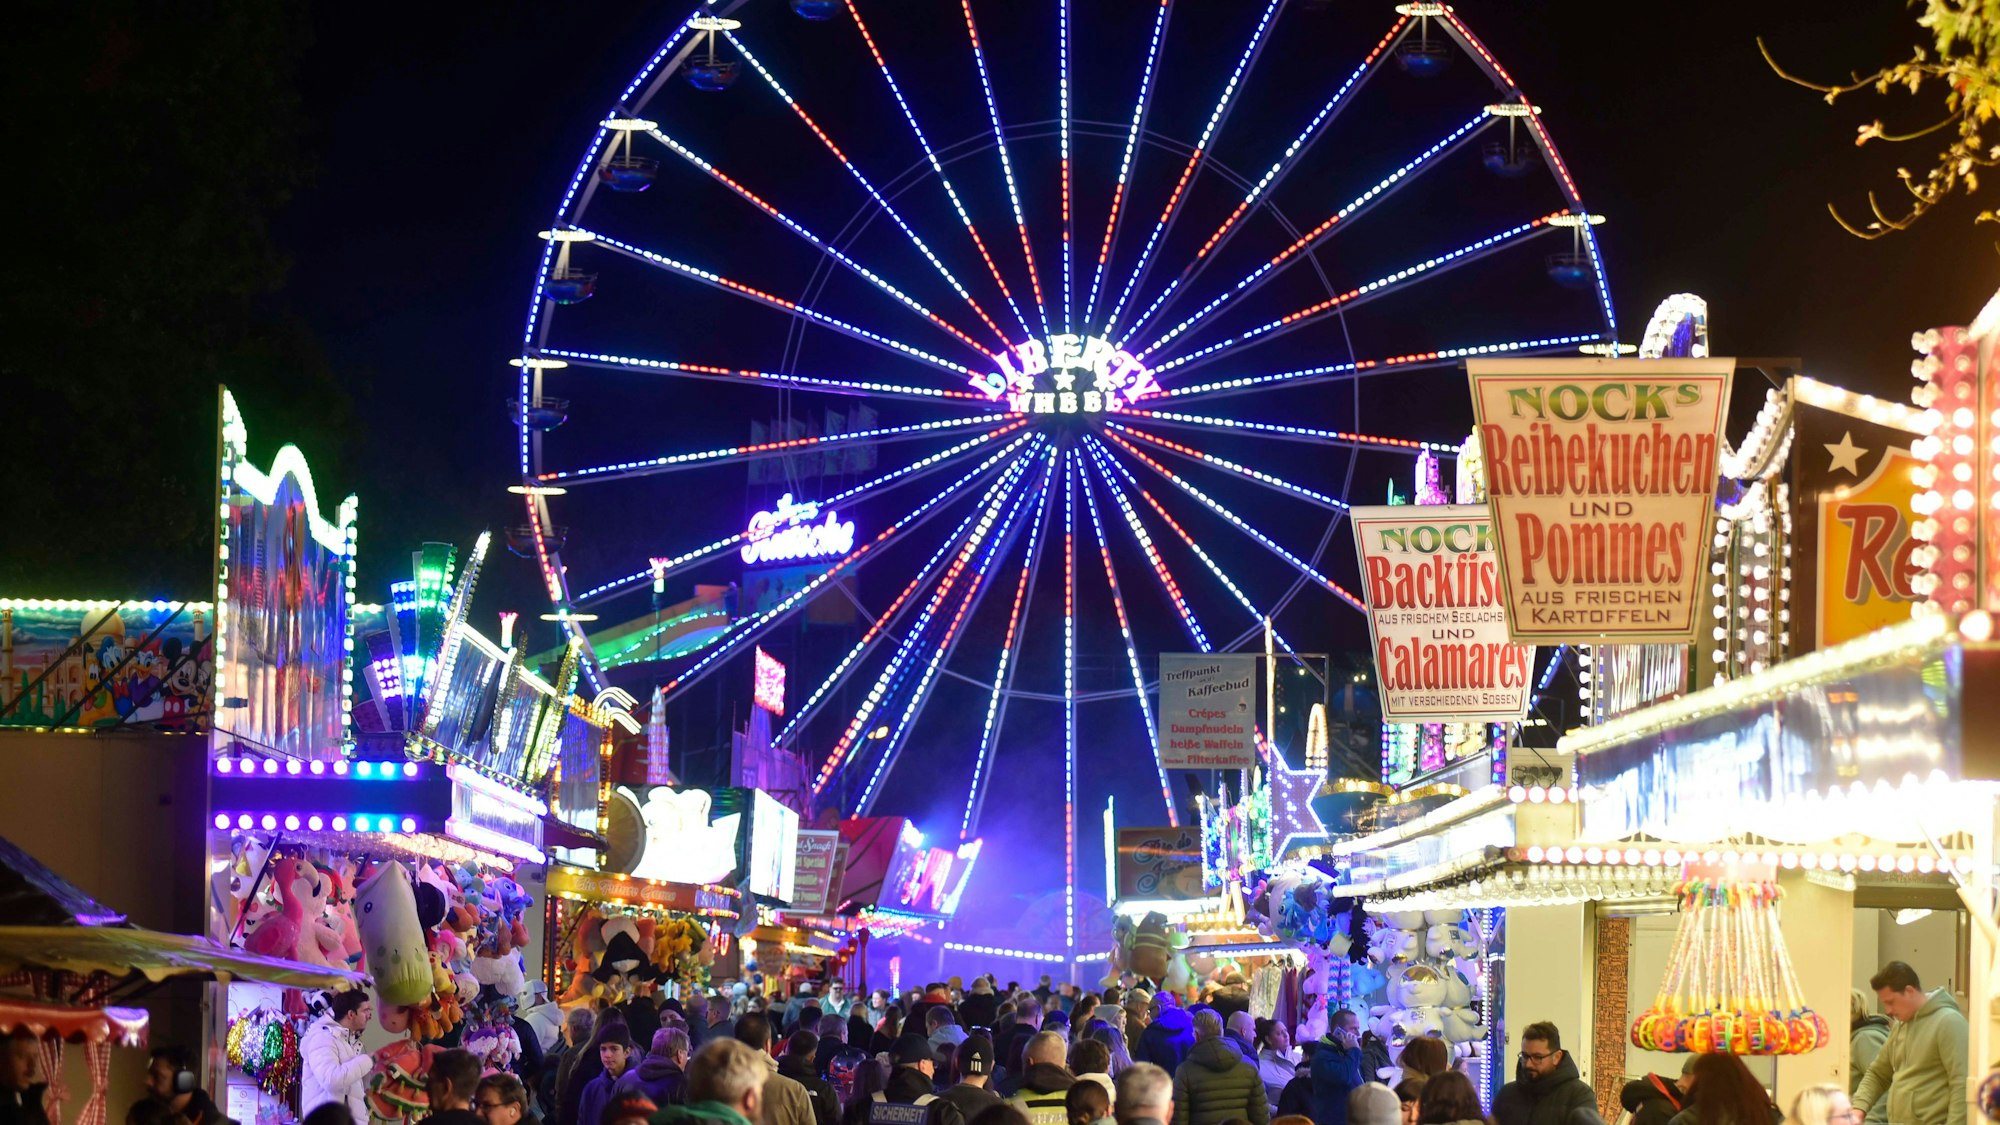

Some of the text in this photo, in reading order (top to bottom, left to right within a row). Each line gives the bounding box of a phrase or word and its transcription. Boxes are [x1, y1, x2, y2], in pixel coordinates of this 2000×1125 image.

[968, 333, 1162, 404] LIBERTY
[1008, 391, 1124, 414] WHEEL
[1482, 422, 1716, 496] Reibekuchen
[1570, 502, 1633, 516] UND
[1515, 512, 1687, 586] Pommes
[1521, 590, 1682, 605] AUS FRISCHEN
[1378, 611, 1507, 625] AUS FRISCHEM SEELACHS
[1531, 608, 1671, 624] KARTOFFELN
[1432, 628, 1475, 640] UND
[1378, 636, 1529, 691] Calamares
[1166, 664, 1221, 681] Treffpunkt
[1188, 678, 1249, 697] Kaffeebud
[1391, 693, 1518, 707] MIT VERSCHIEDENEN SOSSEN
[1171, 724, 1243, 735] Dampfnudeln
[1203, 740, 1243, 749] Waffeln
[1187, 755, 1249, 764] Filterkaffee
[873, 1105, 924, 1123] SICHERHEIT
